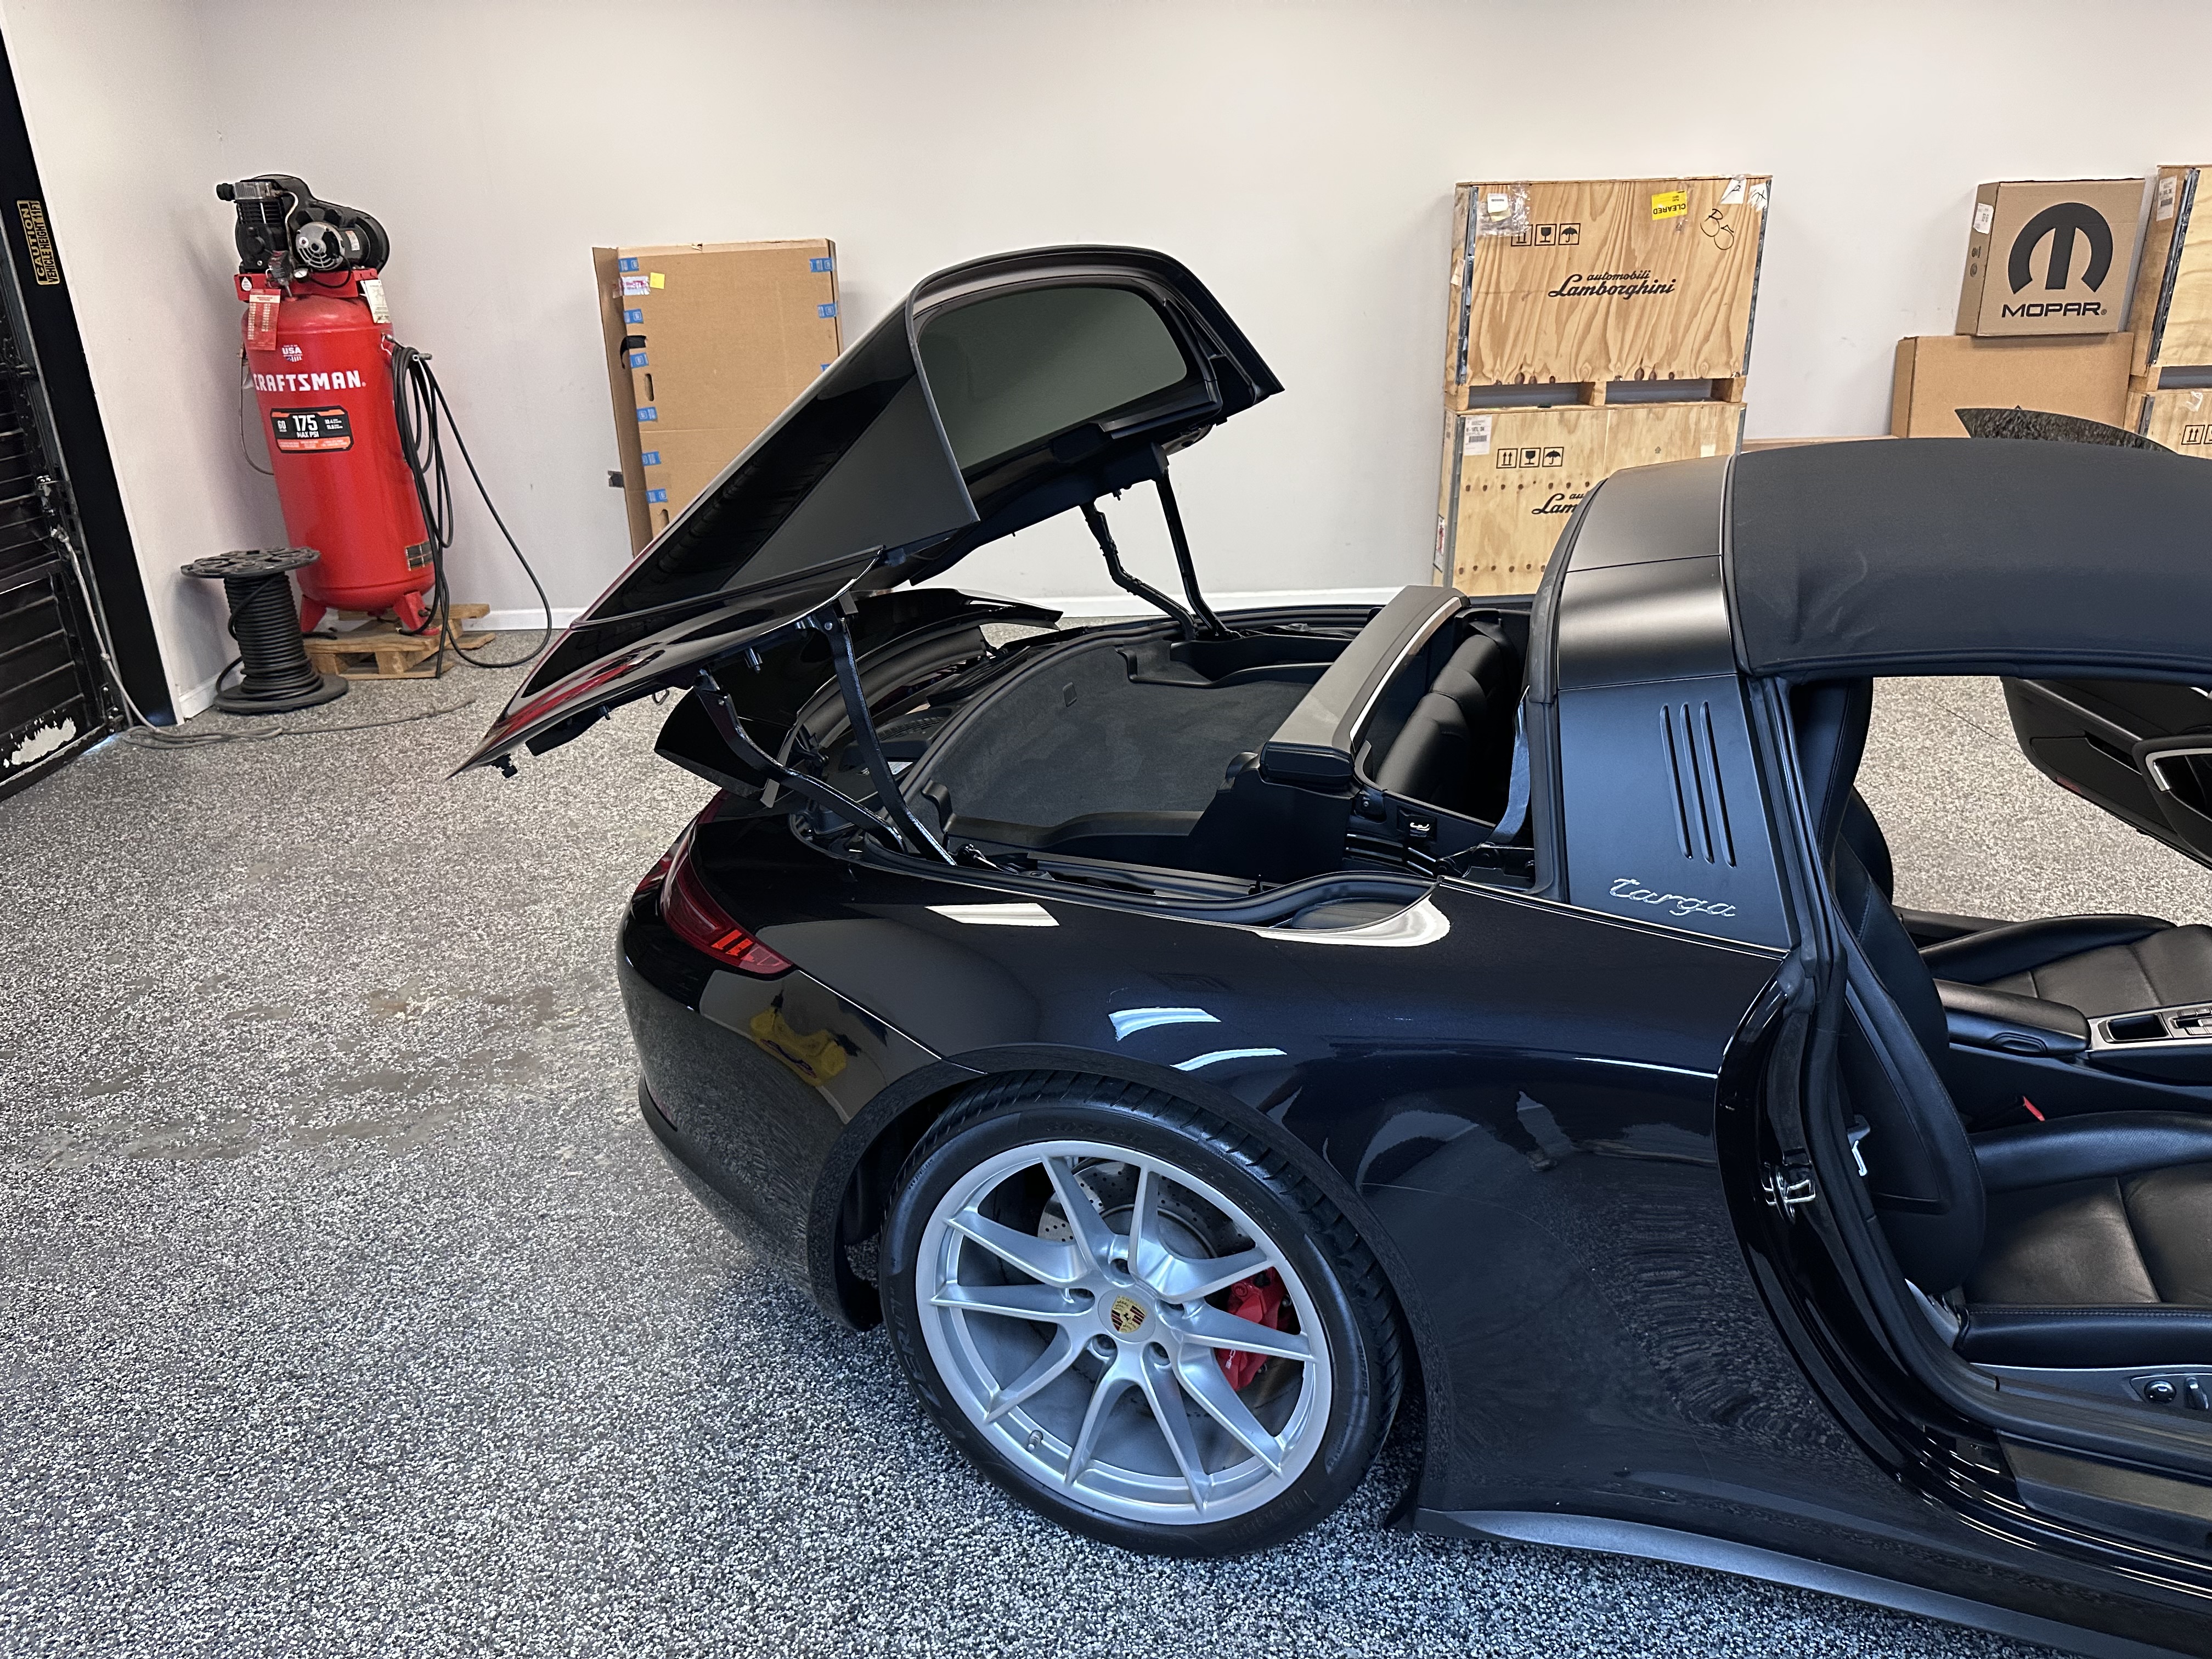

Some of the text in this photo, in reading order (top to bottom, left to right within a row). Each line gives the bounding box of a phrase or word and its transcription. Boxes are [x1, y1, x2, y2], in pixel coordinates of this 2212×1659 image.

[1653, 203, 1686, 215] CLEARED
[21, 208, 45, 276] CAUTION
[34, 221, 50, 250] HEIGHT
[42, 251, 59, 283] VEHICLE
[1587, 269, 1651, 281] automobili
[1548, 274, 1677, 300] Lamborghini
[2001, 302, 2101, 318] MOPAR
[281, 347, 302, 355] USA
[277, 420, 286, 430] 60
[292, 414, 318, 432] 175
[1609, 878, 1735, 917] targa
